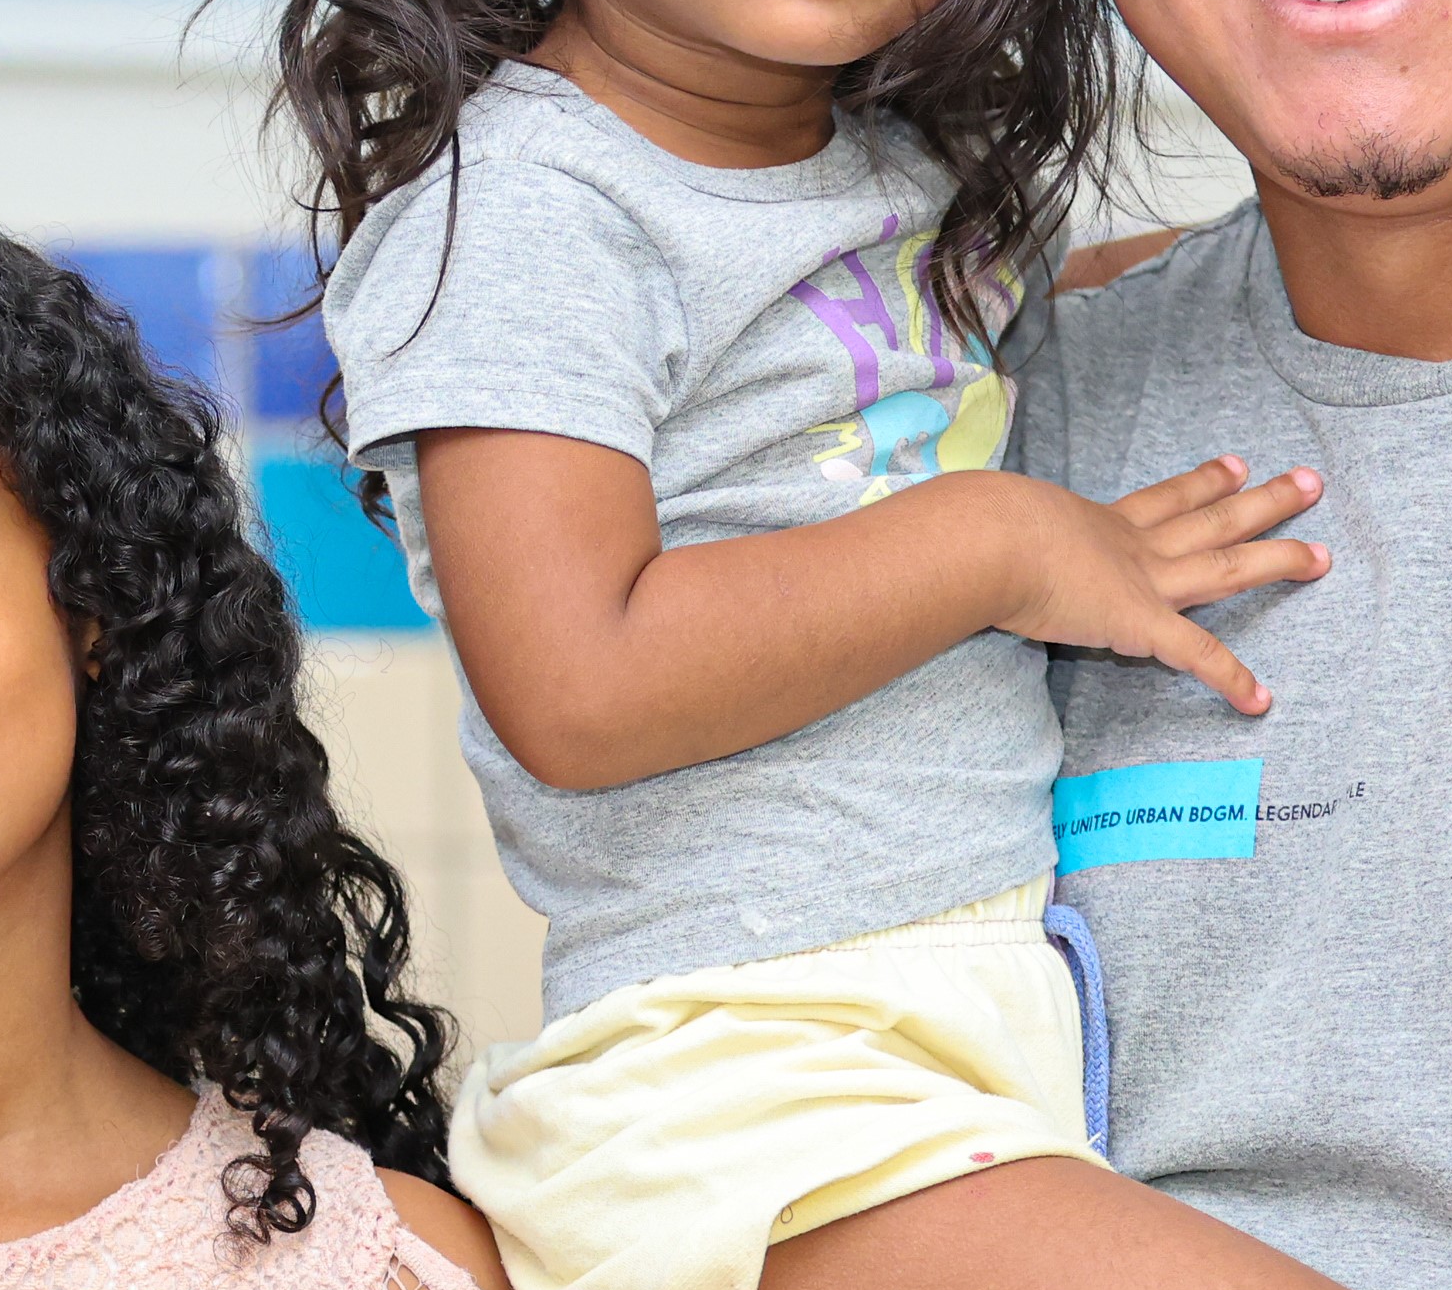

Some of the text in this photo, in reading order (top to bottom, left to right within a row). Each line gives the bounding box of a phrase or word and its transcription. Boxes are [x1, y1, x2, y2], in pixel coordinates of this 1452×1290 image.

[1070, 812, 1121, 836] UNITED
[1126, 805, 1185, 826] URBAN
[1188, 804, 1248, 823] BDGM.
